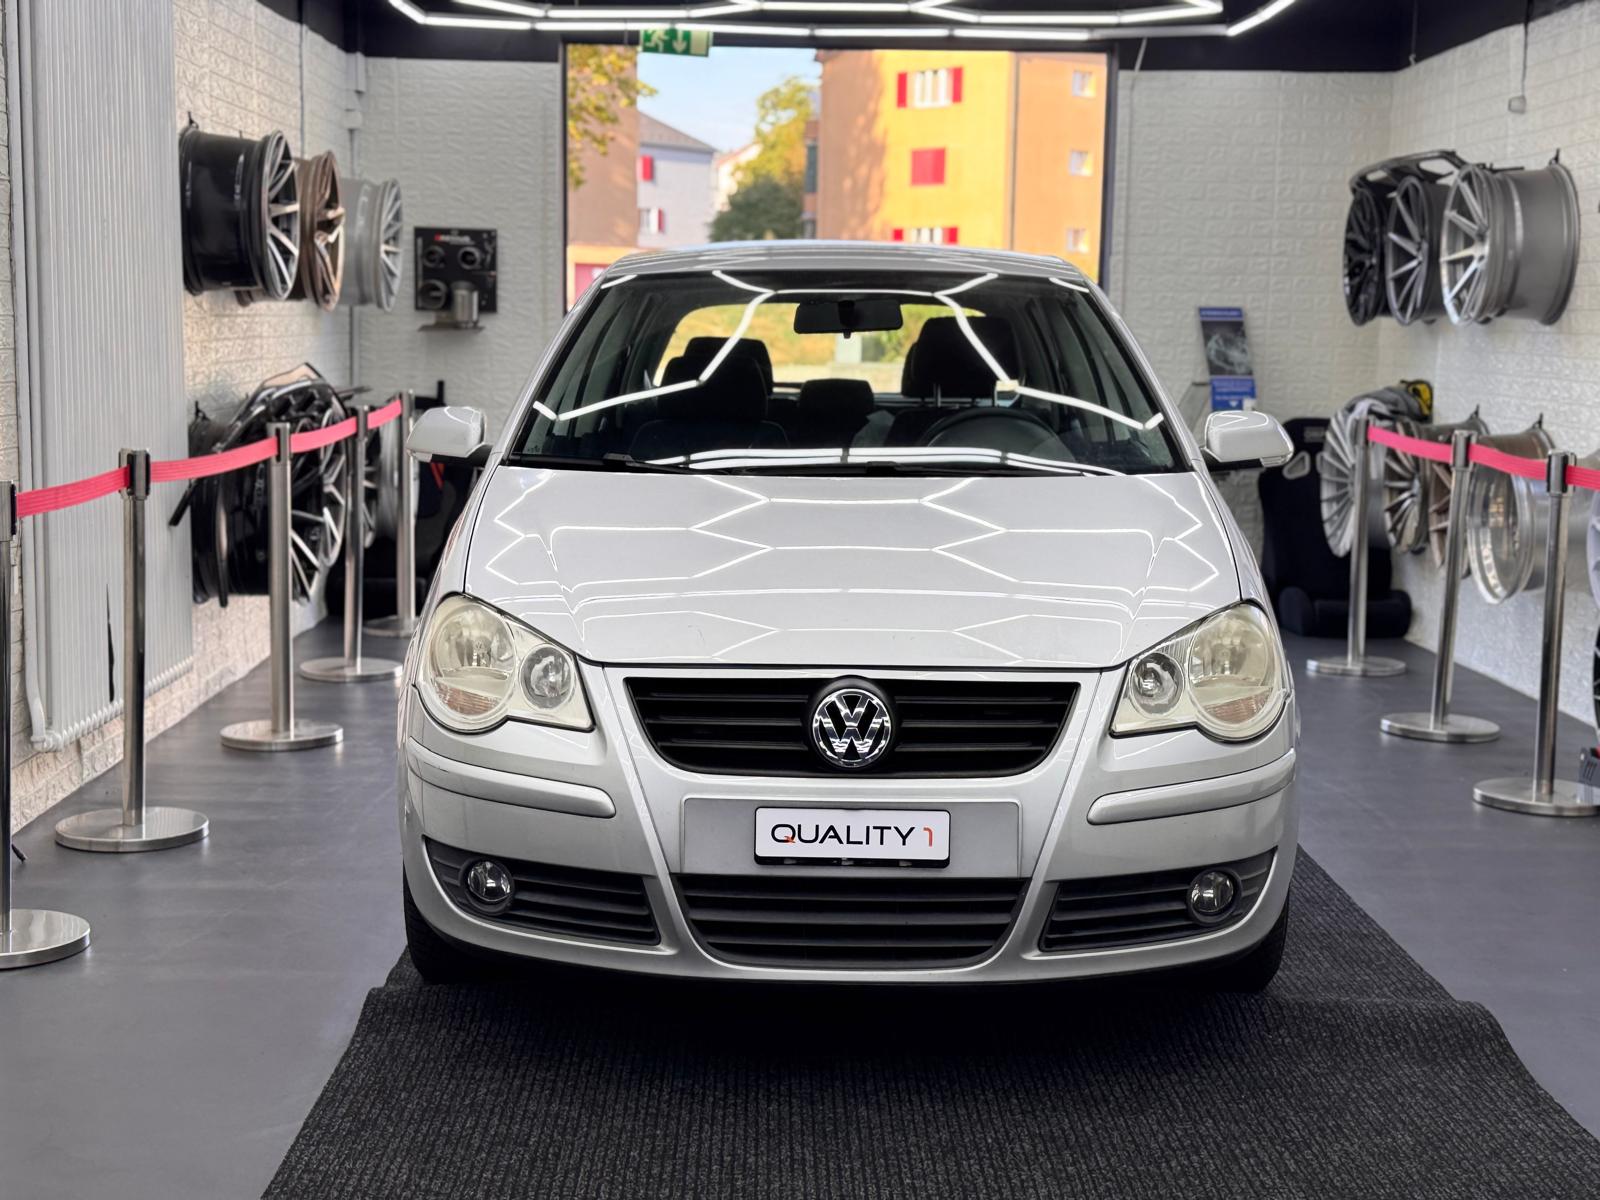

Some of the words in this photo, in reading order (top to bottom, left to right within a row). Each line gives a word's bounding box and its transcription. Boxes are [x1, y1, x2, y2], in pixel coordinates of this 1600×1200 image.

[813, 688, 891, 767] VW
[771, 823, 915, 846] QUALITY
[923, 826, 934, 847] 1
